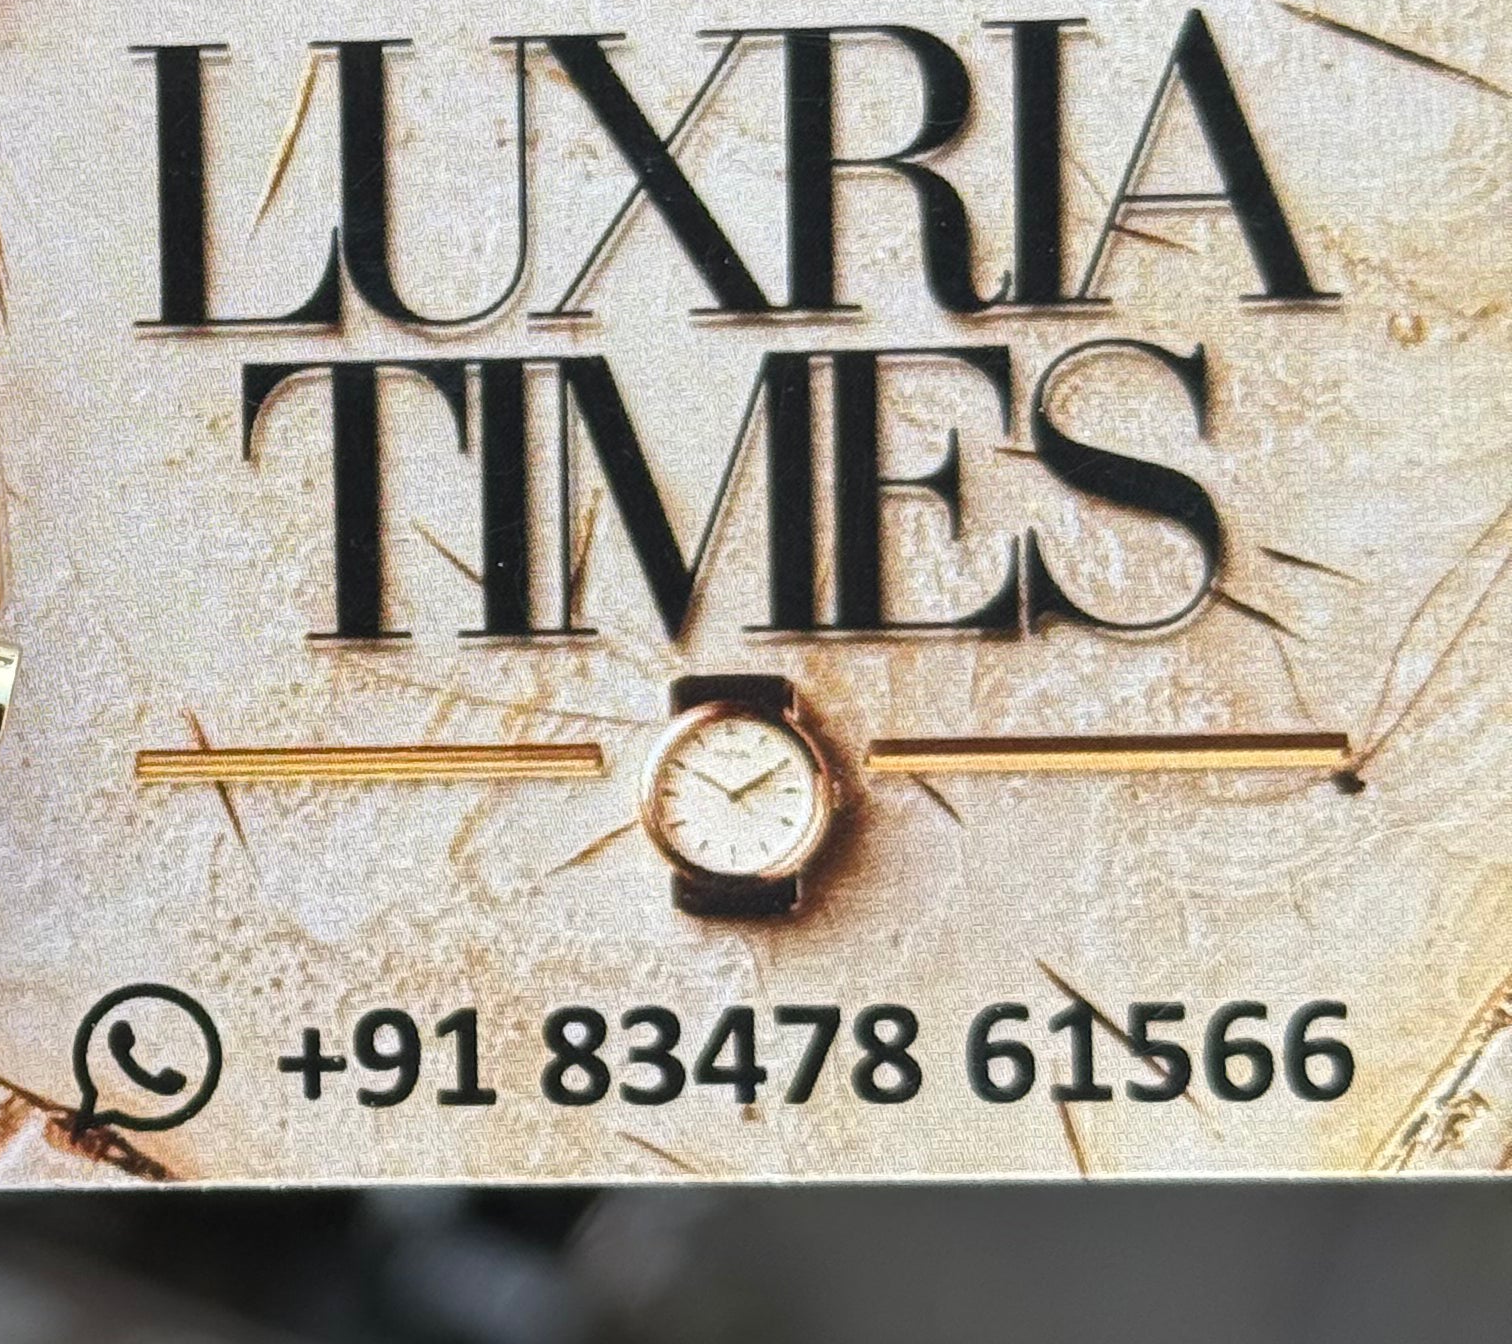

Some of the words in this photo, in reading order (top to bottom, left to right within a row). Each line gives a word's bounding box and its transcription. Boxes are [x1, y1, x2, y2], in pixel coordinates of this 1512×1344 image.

[128, 8, 1341, 326] LUXRIA
[242, 338, 1227, 641] TIMES
[277, 1007, 497, 1108] +91
[541, 1002, 922, 1106] 83478
[966, 1000, 1356, 1103] 61566
